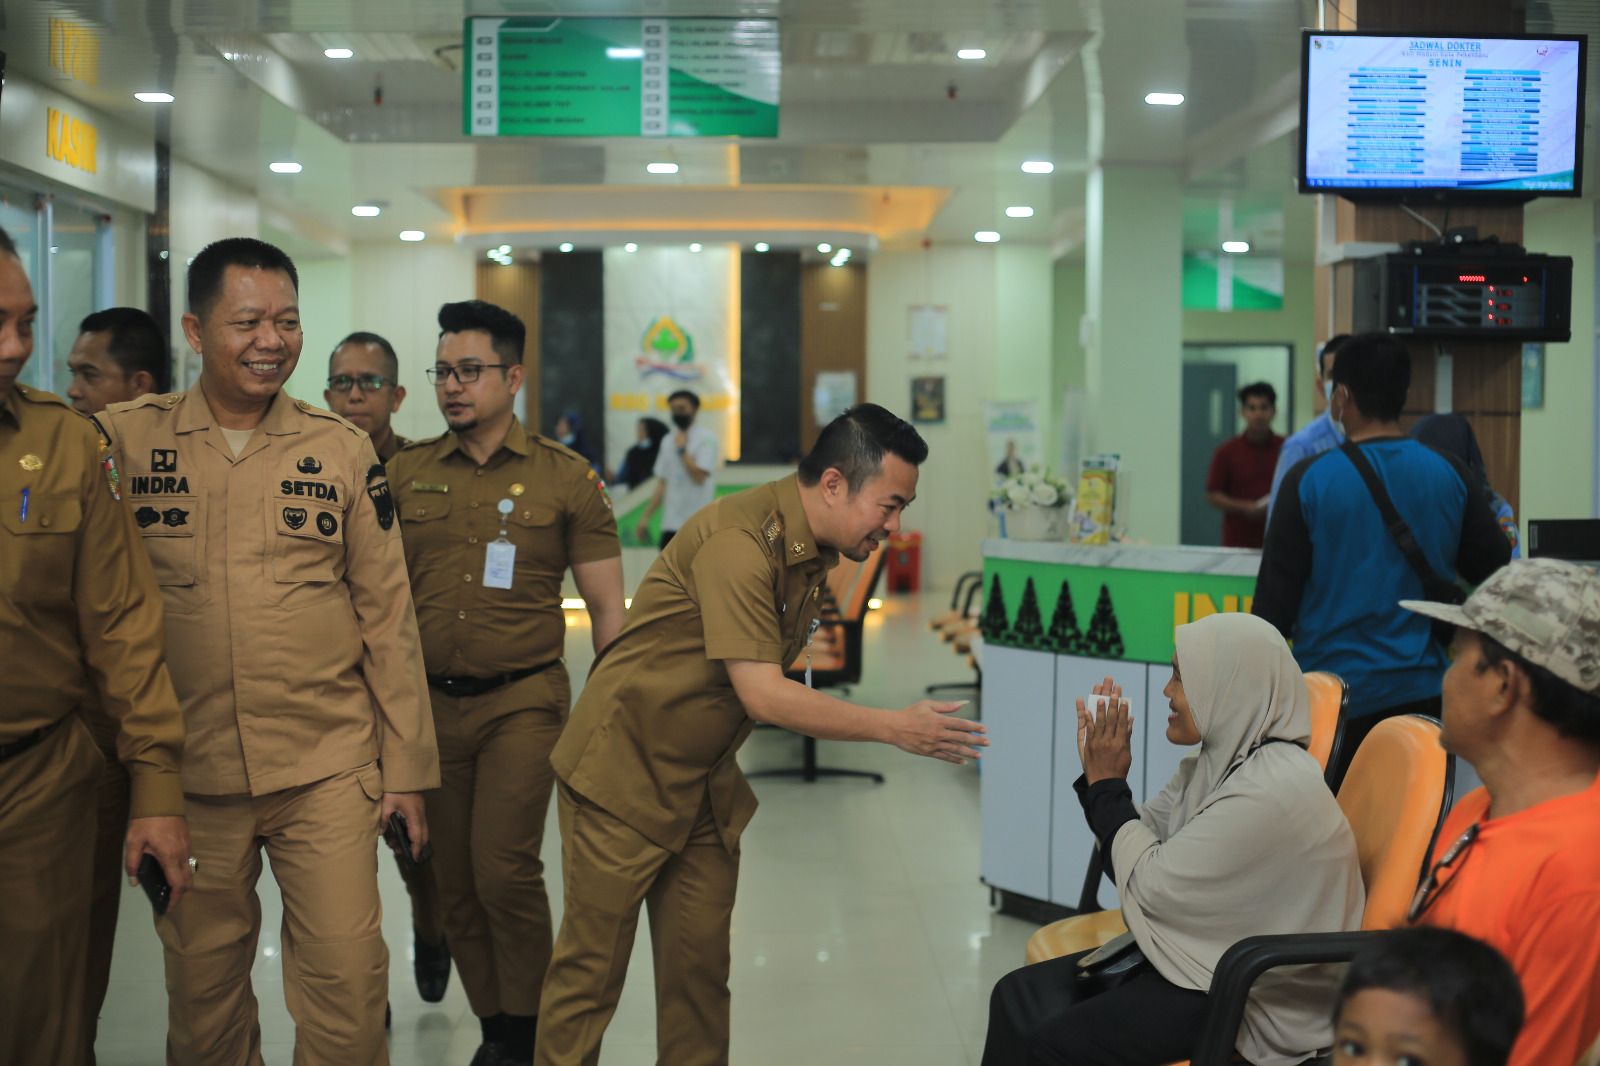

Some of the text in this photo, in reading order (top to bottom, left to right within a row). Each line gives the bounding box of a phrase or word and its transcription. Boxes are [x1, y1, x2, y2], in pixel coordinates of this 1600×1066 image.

[1409, 40, 1481, 50] JADWAL DOKTER
[1428, 58, 1462, 67] SENIN
[47, 106, 98, 175] KASIR
[131, 476, 190, 495] INDRA
[280, 479, 339, 503] SETDA
